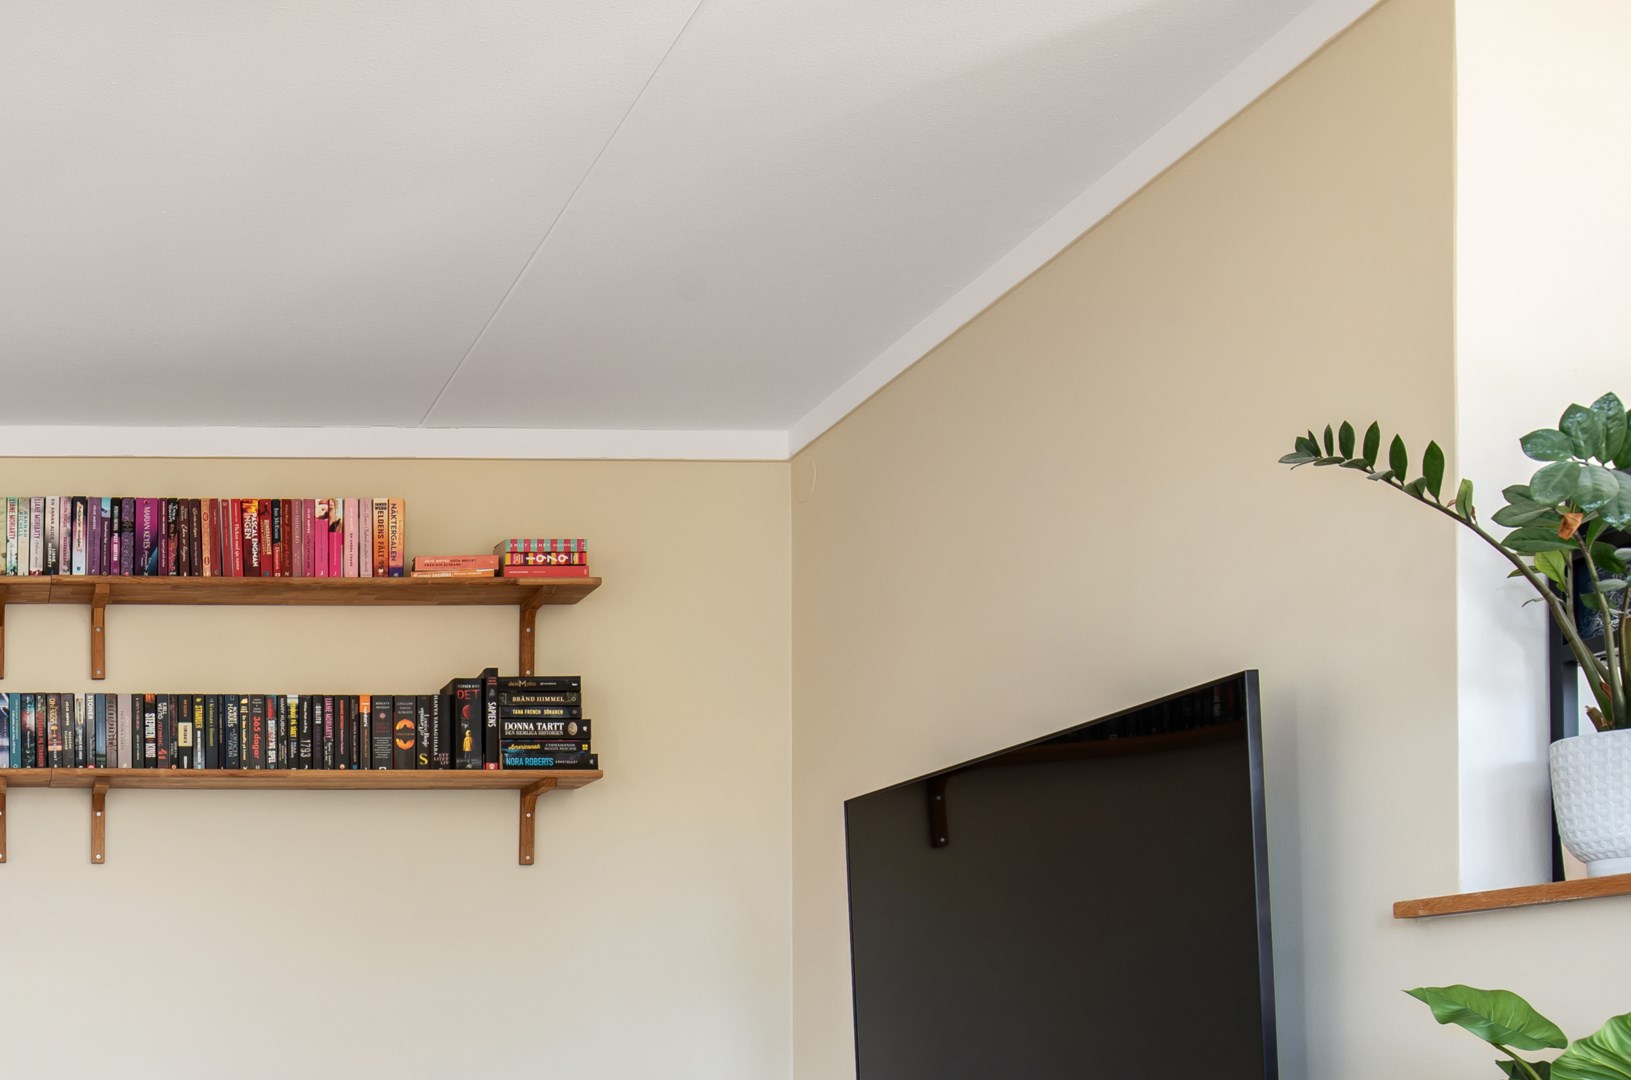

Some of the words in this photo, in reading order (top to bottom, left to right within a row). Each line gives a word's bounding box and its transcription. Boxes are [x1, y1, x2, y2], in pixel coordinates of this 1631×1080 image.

[390, 503, 398, 561] NÄKTERGALEN
[377, 541, 385, 558] FÄLT
[457, 689, 481, 700] DET
[253, 716, 261, 732] 365
[488, 702, 497, 728] SAPIENS
[145, 713, 156, 738] STEPHEN
[325, 713, 333, 738] MORIARTY
[505, 722, 534, 730] DONNA
[536, 722, 565, 730] TARTT
[145, 743, 156, 758] KING
[252, 733, 261, 759] dagar
[300, 739, 311, 758] 1793
[506, 757, 524, 766] NORA
[524, 757, 554, 766] ROBERTS
